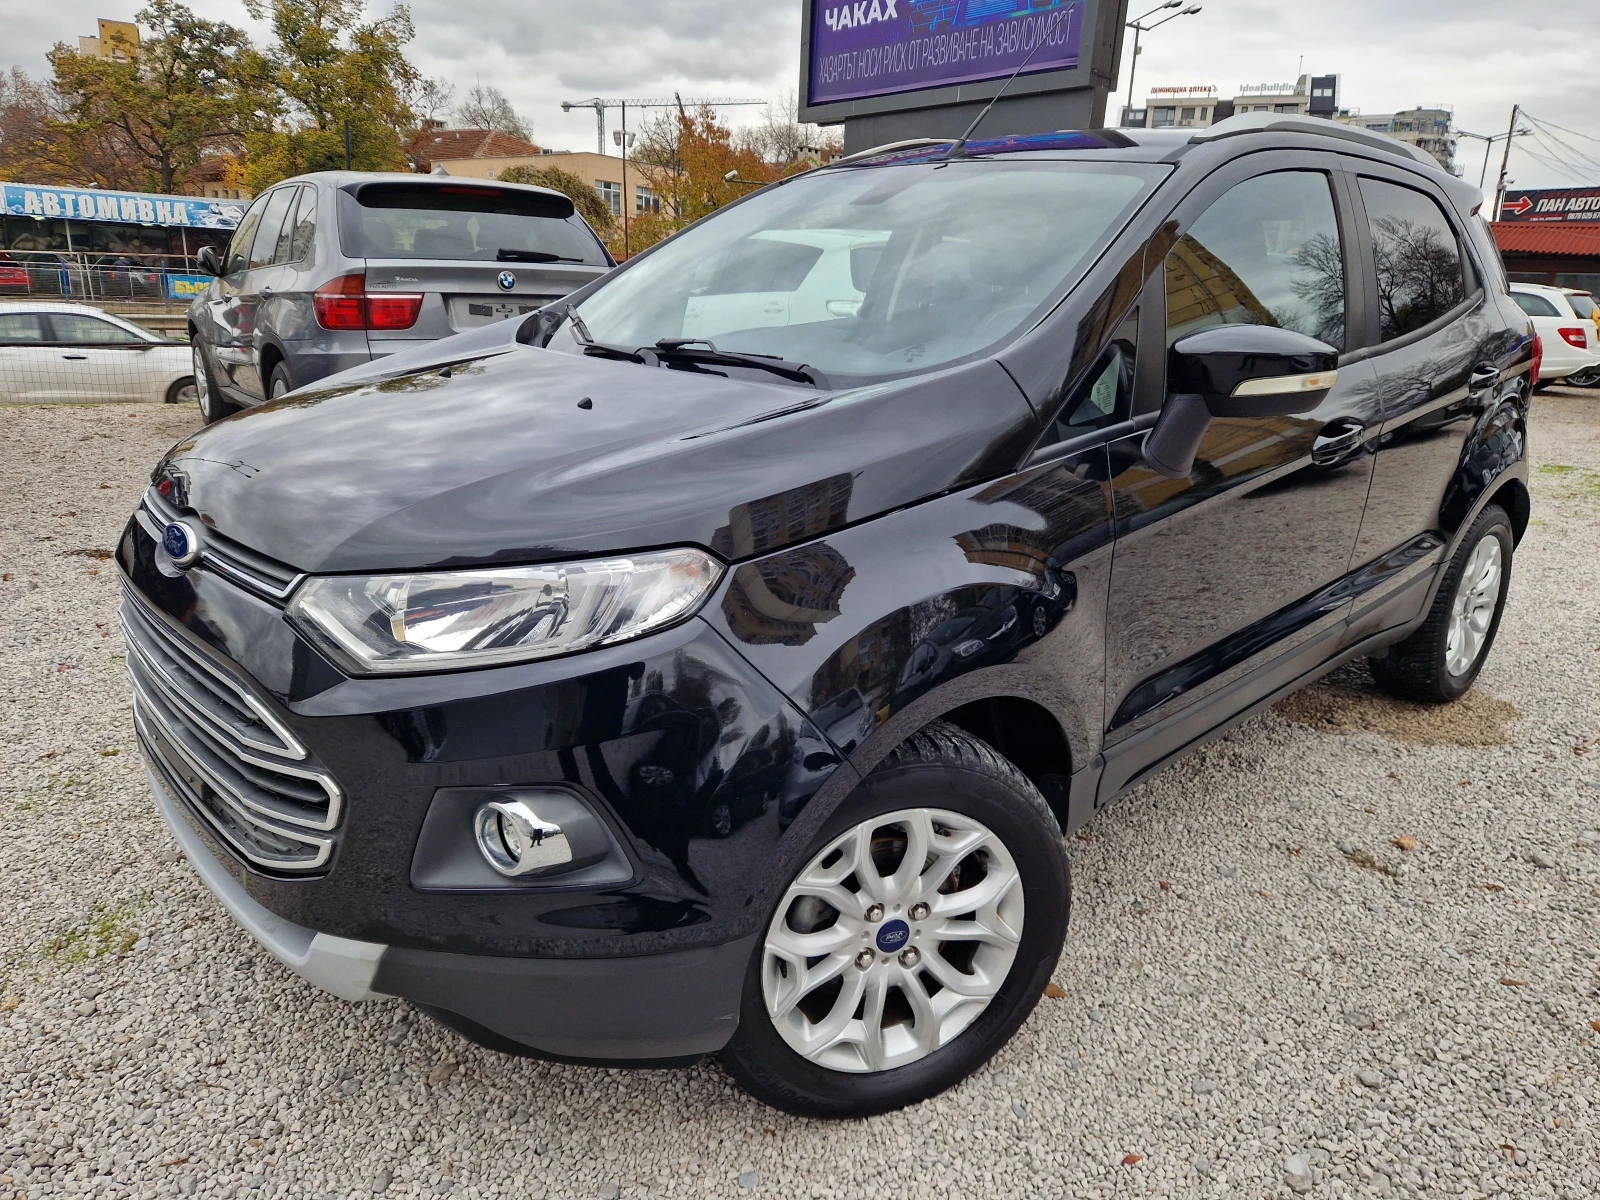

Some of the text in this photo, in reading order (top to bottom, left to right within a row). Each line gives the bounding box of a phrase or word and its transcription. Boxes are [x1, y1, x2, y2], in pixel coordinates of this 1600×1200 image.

[825, 0, 898, 31] ЧАКАХ
[819, 8, 1075, 84] ХАЗАРТЪТ НОСИ РИСК ОТ РАЗВИВАНЕ НА ЗАВИСИМОСТ
[24, 190, 190, 225] АВТОМИВКА
[1534, 198, 1567, 212] ПАН
